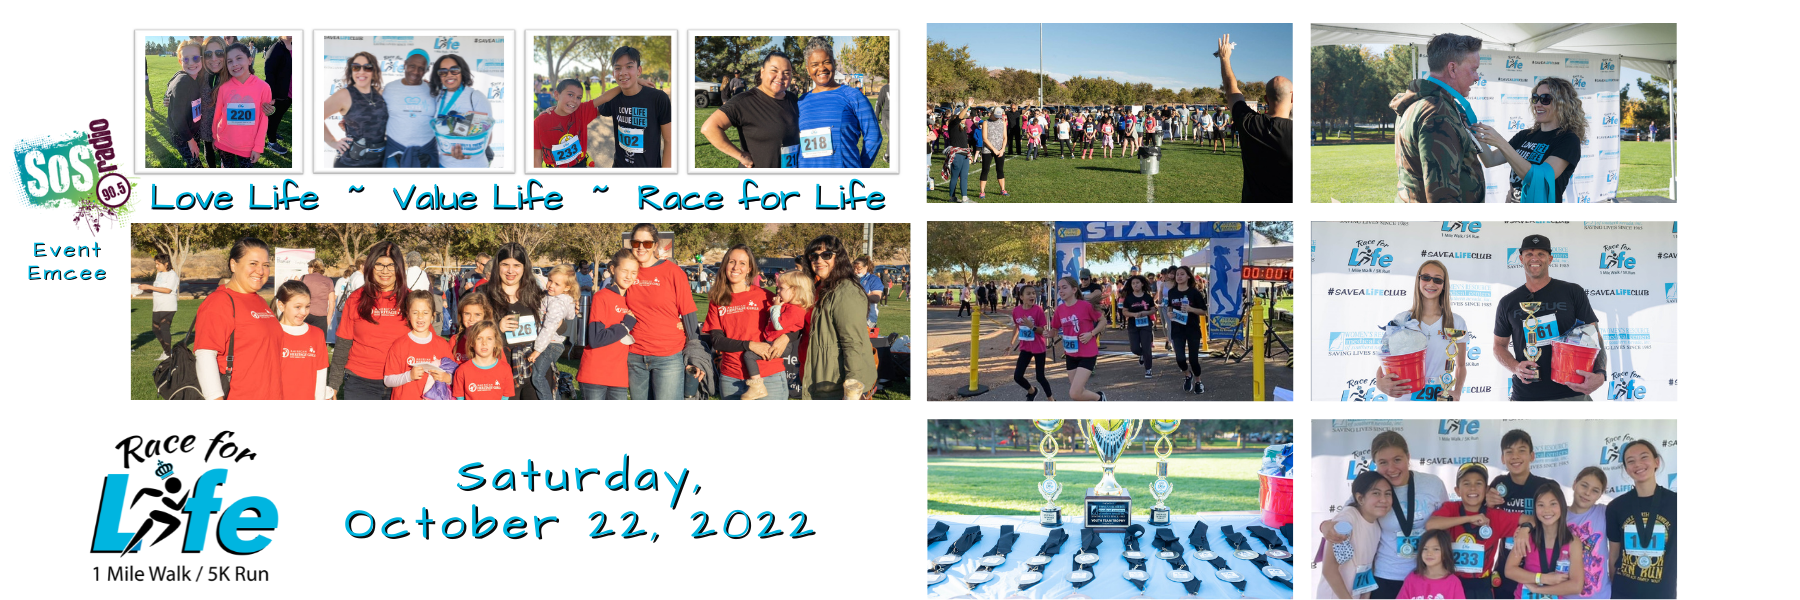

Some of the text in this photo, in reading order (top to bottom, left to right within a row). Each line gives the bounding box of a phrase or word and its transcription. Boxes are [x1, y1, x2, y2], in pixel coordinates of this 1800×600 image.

[230, 110, 252, 120] 220
[633, 107, 646, 116] LIFE
[633, 117, 646, 126] LIFE
[804, 136, 828, 151] 218
[556, 144, 578, 160] 233
[1087, 222, 1201, 239] START
[1356, 240, 1389, 248] Race for
[1348, 248, 1393, 268] Life
[1599, 251, 1636, 270] Life
[1612, 371, 1629, 380] Race
[1347, 379, 1368, 388] Race
[1607, 379, 1647, 401] Life
[1605, 435, 1621, 445] Race
[1352, 449, 1371, 459] Race
[1630, 535, 1657, 549] 11
[1453, 552, 1479, 566] 233
